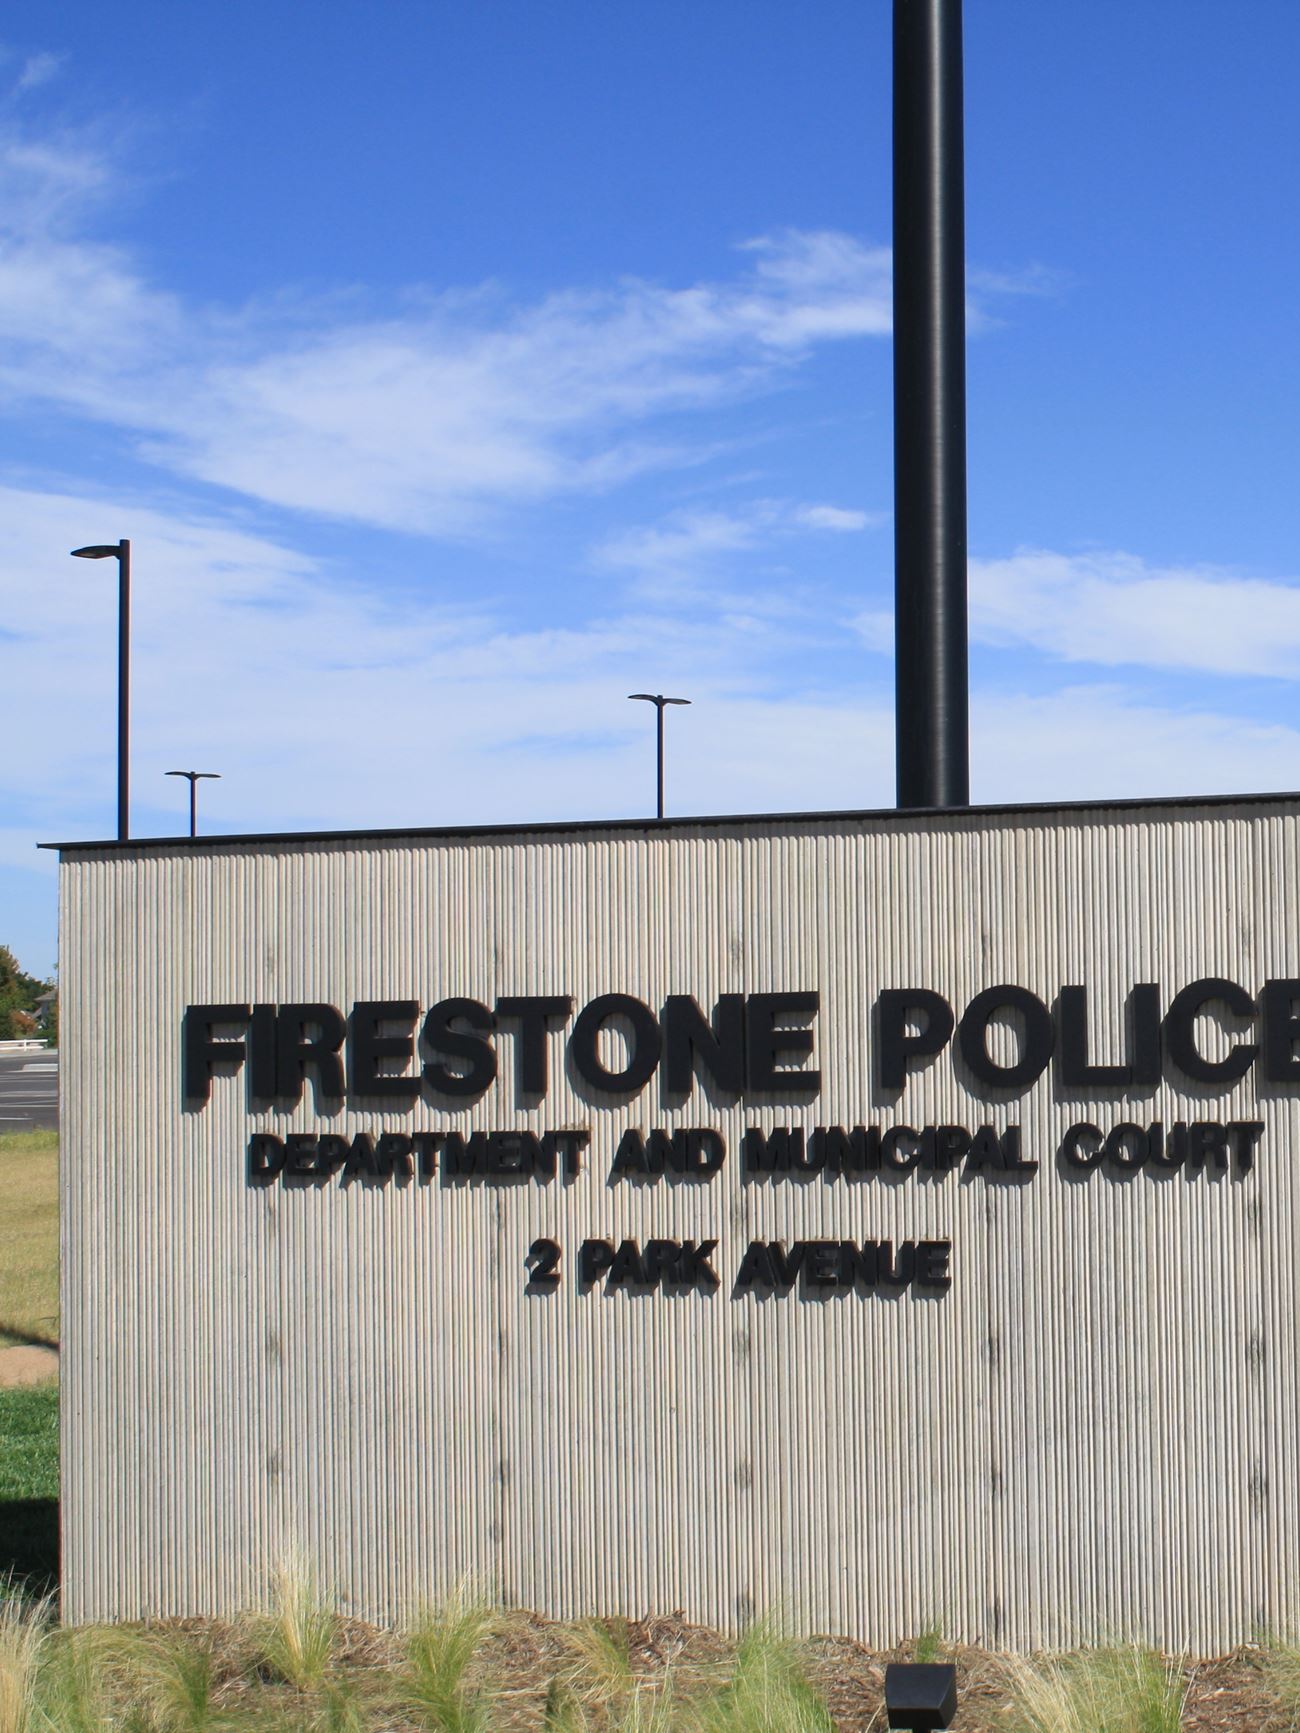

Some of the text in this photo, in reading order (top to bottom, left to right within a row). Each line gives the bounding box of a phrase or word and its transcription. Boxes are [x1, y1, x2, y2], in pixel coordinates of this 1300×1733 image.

[186, 991, 820, 1100] FIRESTONE
[250, 1121, 1265, 1176] DEPARTMENT AND MUNICIPAL COURT
[528, 1239, 952, 1287] 2 PARK AVENUE
